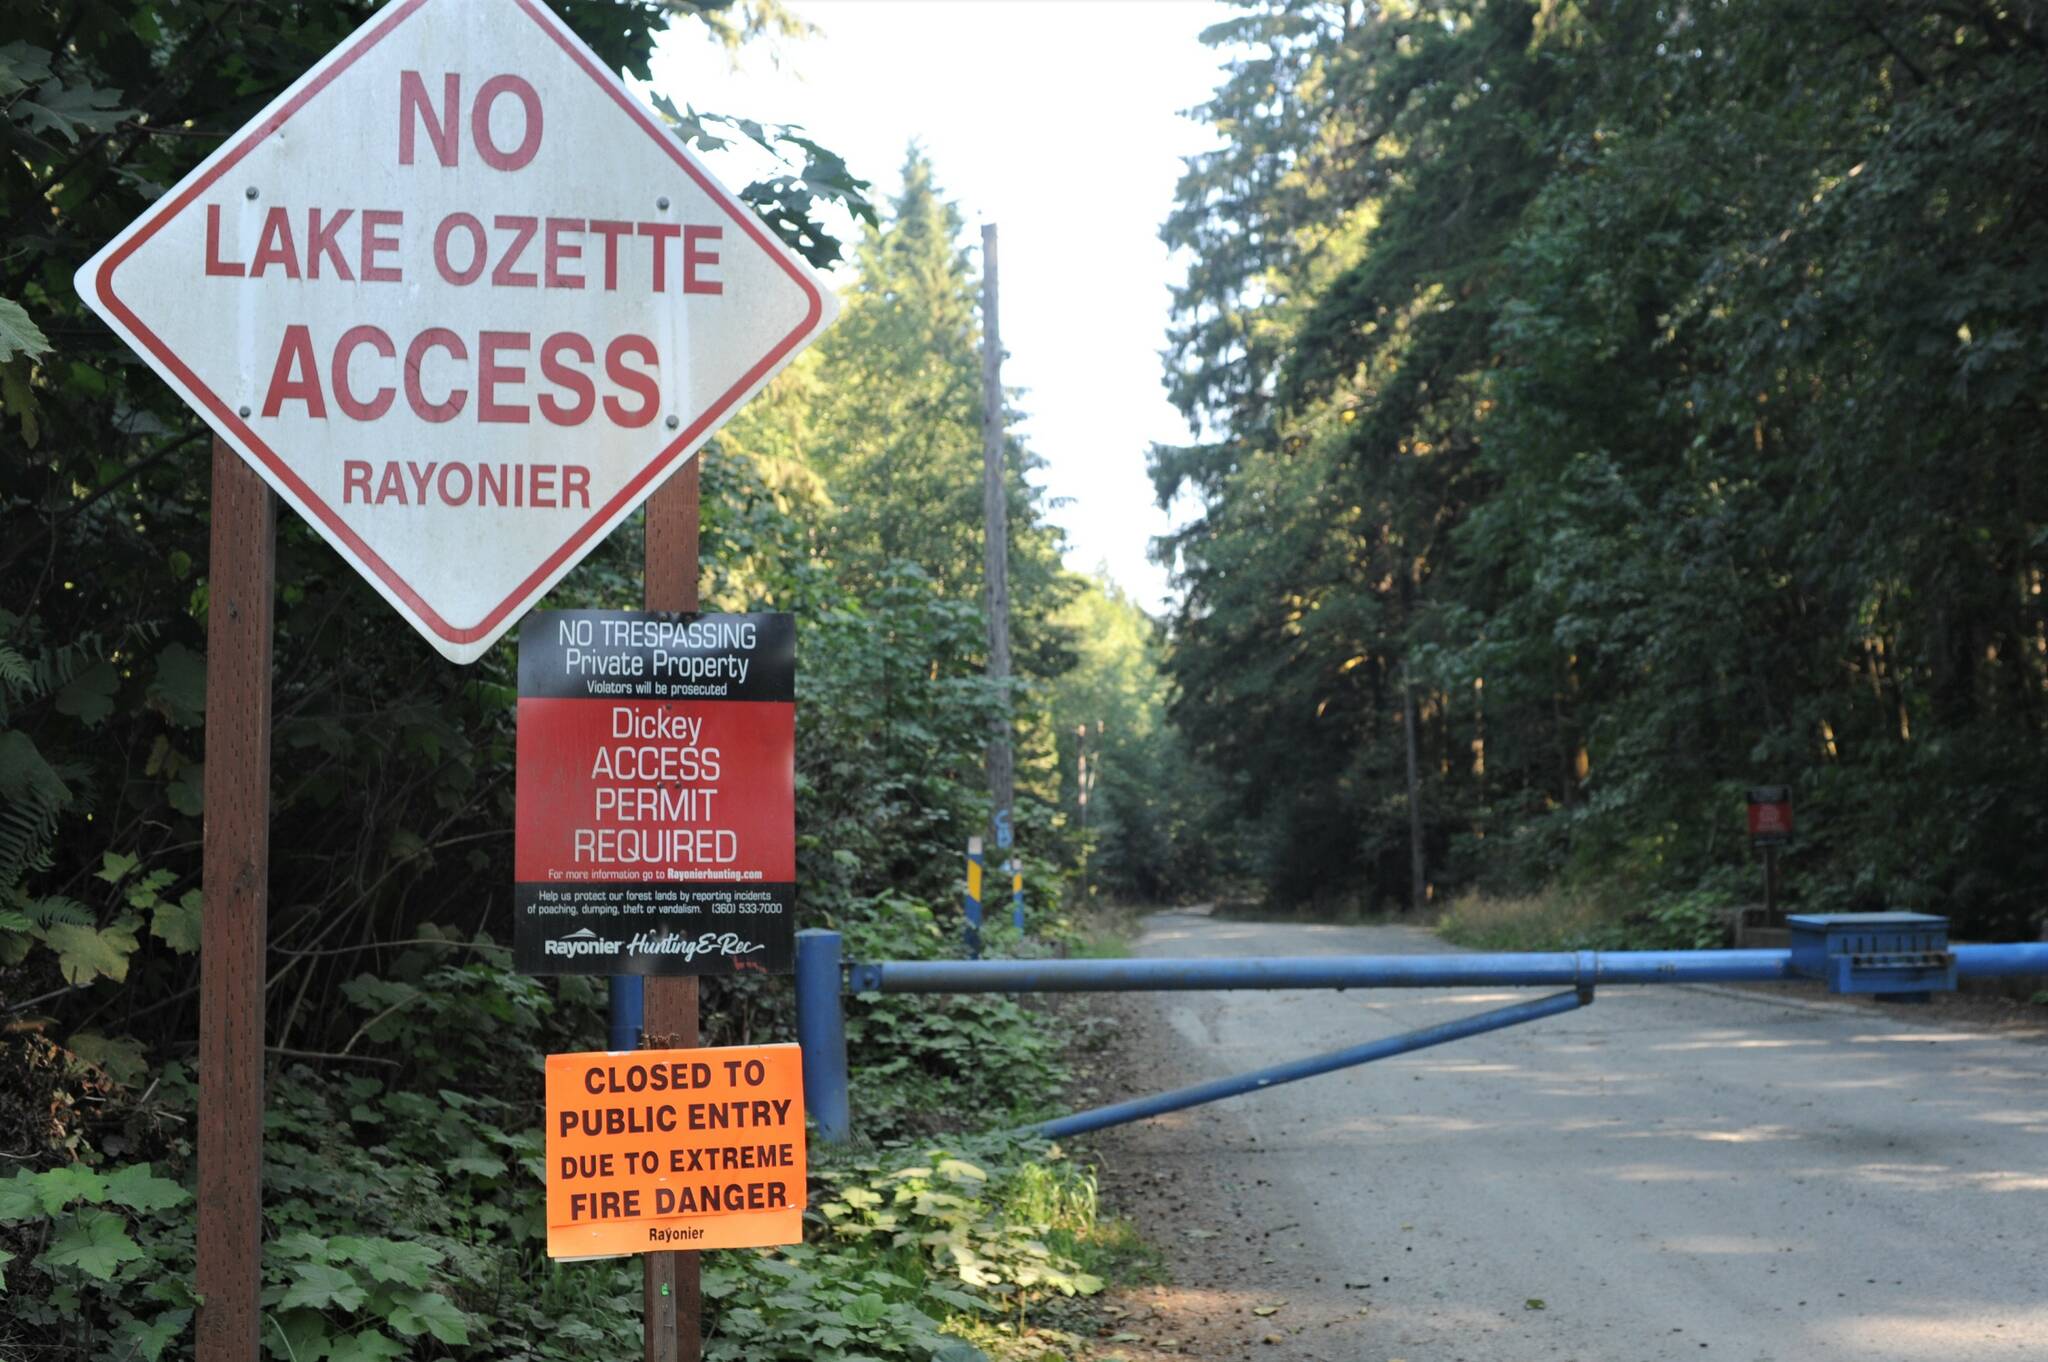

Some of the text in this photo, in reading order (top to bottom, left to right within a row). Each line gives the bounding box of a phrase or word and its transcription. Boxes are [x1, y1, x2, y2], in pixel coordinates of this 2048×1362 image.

[399, 70, 544, 171] NO
[204, 203, 724, 296] LAKE OZETTE
[261, 323, 661, 430] ACCESS
[342, 459, 592, 509] RAYONIER
[559, 620, 756, 650] NO TRESPASSING
[566, 648, 749, 684] Private Property
[587, 680, 728, 697] Violators will be prosecuted
[612, 707, 703, 746] Dickey
[591, 746, 720, 781] ACCESS
[595, 787, 718, 822] PERMIT
[574, 829, 737, 863] REQUIRED
[548, 868, 763, 882] For more information go to Rayonierhunting.com
[527, 903, 783, 916] of poaching, dumping, theft or vandalism. (360) 533-7000
[539, 890, 771, 902] Help us protect our forest lands by reporting incidents
[545, 938, 621, 959] Rayonier
[584, 1060, 765, 1095] CLOSED TO
[560, 1099, 792, 1137] PUBLIC ENTRY
[561, 1143, 794, 1180] DUE TO EXTREME
[571, 1181, 787, 1221] FIRE DANGER
[649, 1227, 704, 1243] Rayonier
